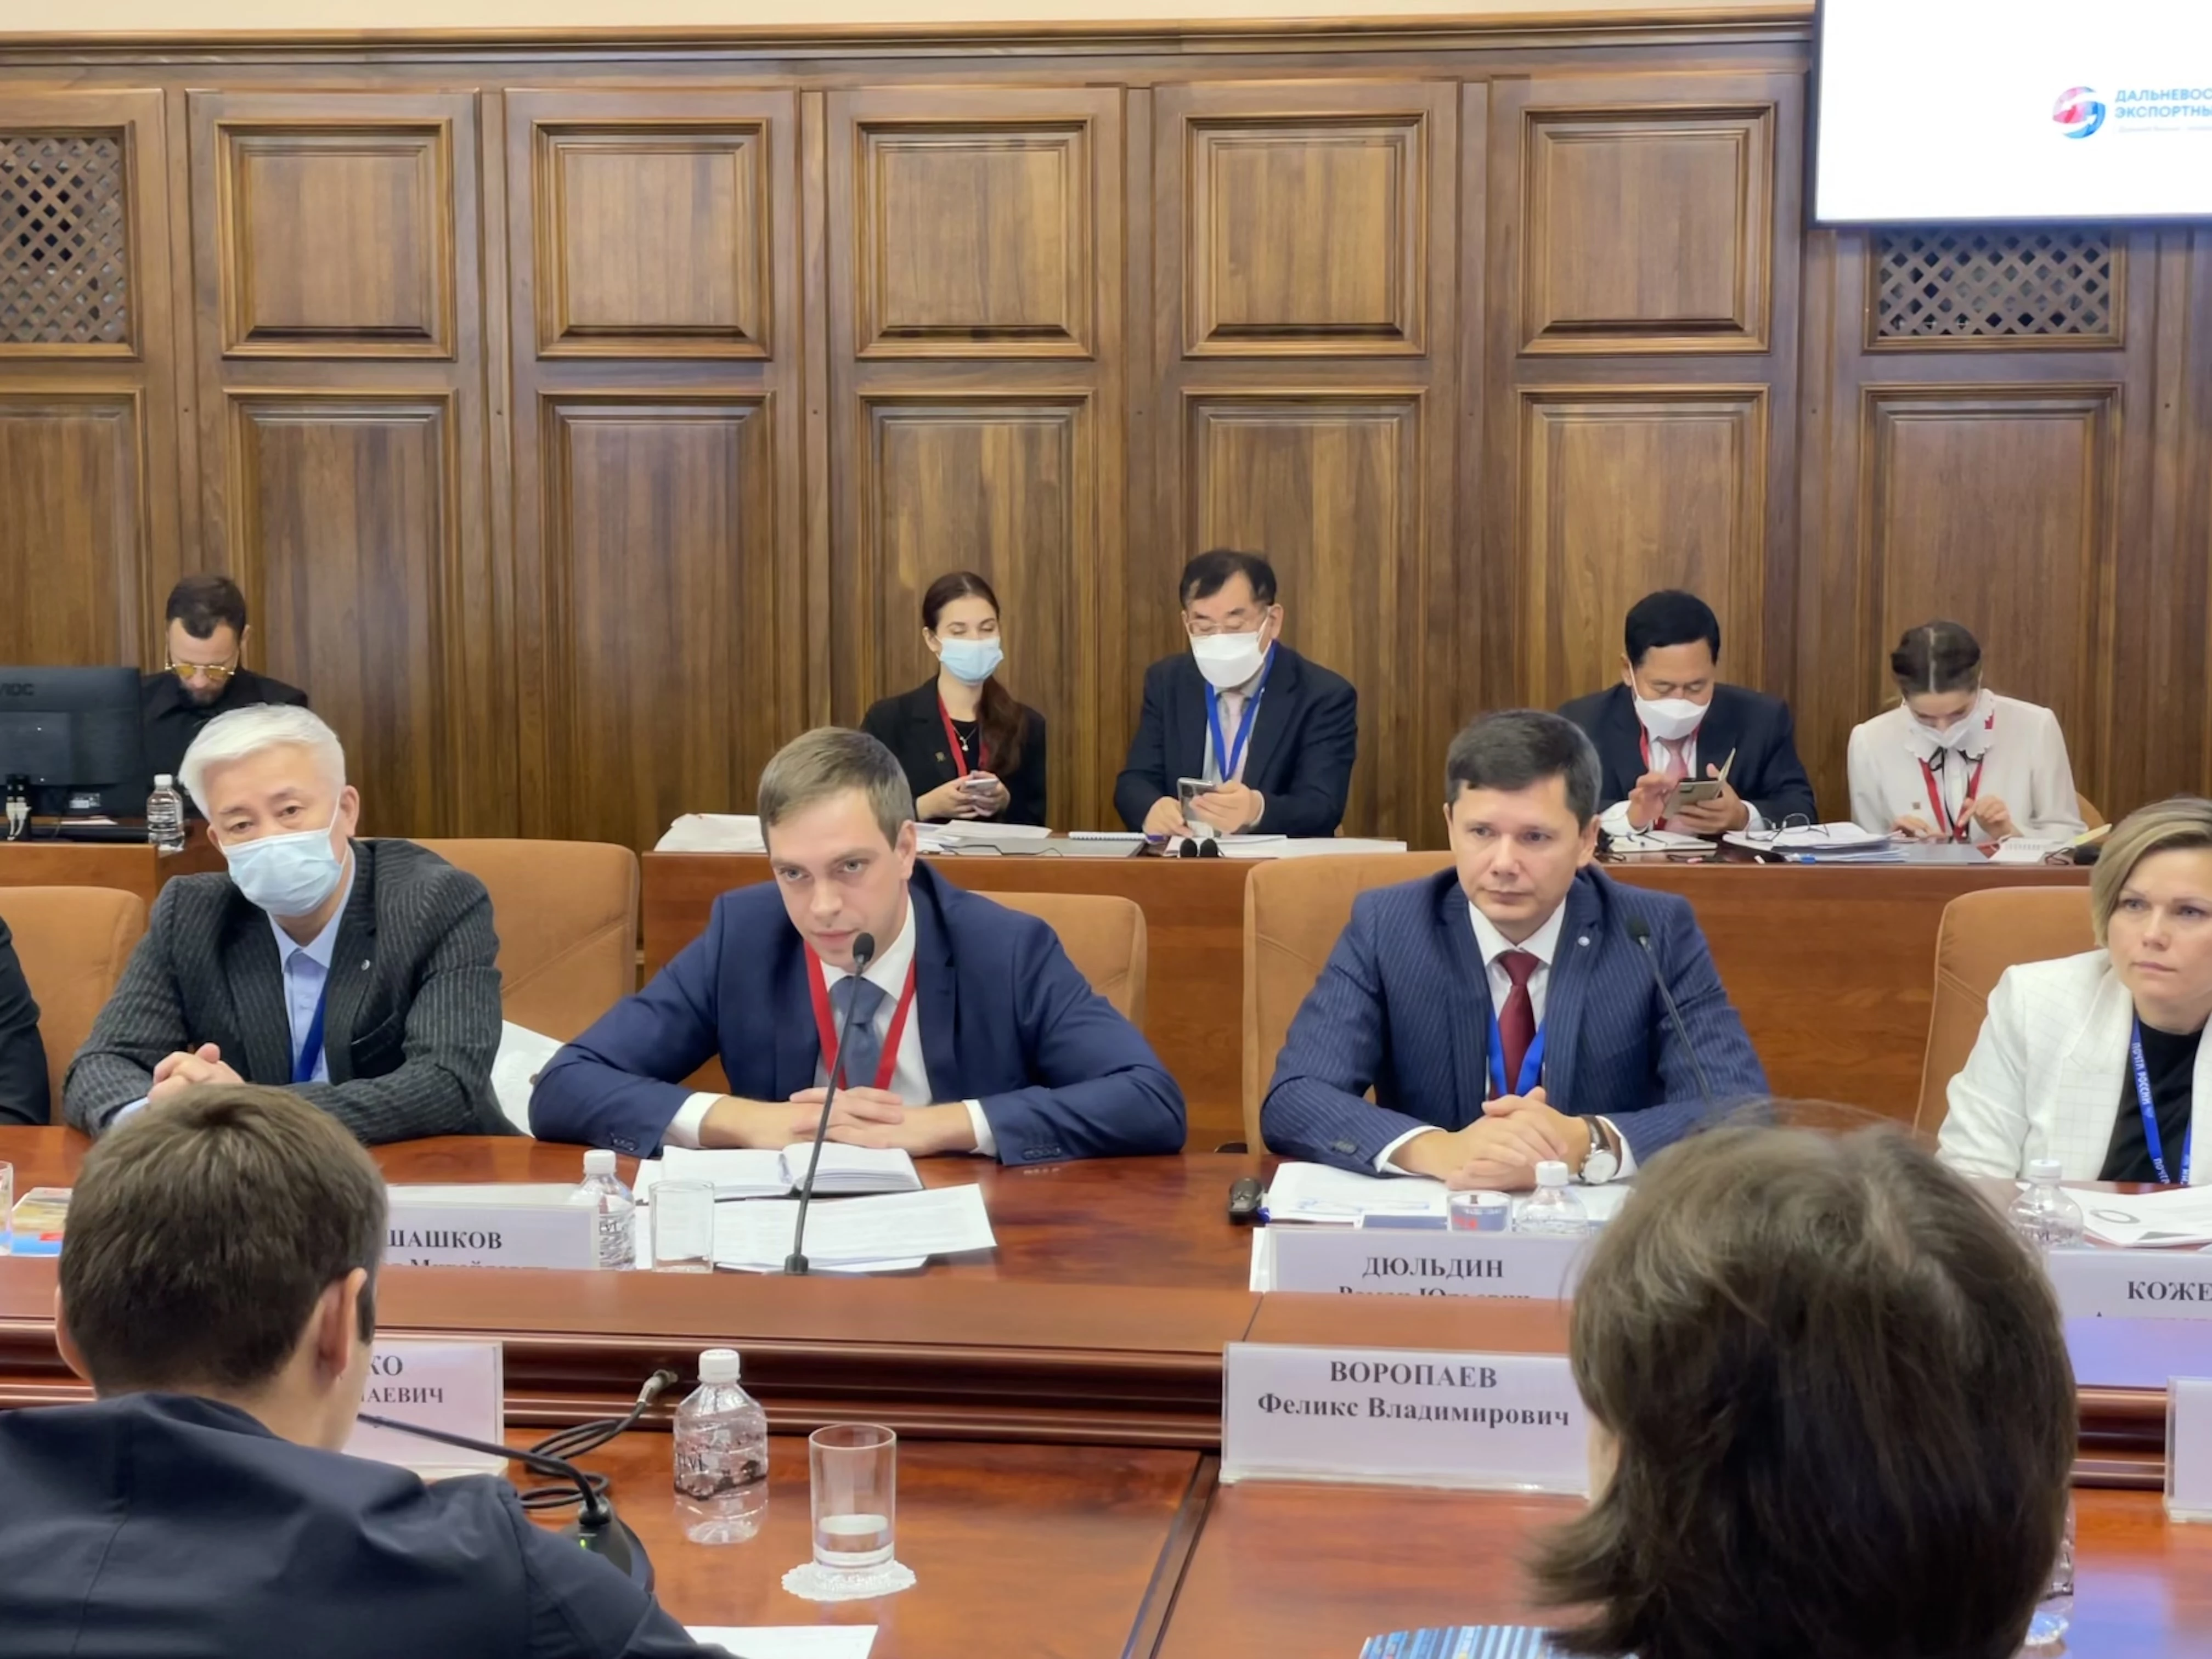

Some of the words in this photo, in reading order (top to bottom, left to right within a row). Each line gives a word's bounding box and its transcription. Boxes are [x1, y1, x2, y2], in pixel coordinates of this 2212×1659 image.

[2115, 88, 2212, 103] ДАЛЬНЕВОС
[2132, 1042, 2145, 1070] ПОЧТА
[2137, 1071, 2151, 1105] РОССИИ
[1362, 1256, 1504, 1280] ДЮЛЬДИН
[2127, 1280, 2212, 1301] КОЖЕ
[1330, 1361, 1498, 1389] ВОРОПАЕВ
[360, 1387, 443, 1403] АЕВИЧ
[1257, 1392, 1358, 1417] Феликс
[1368, 1397, 1570, 1428] Владимирович
